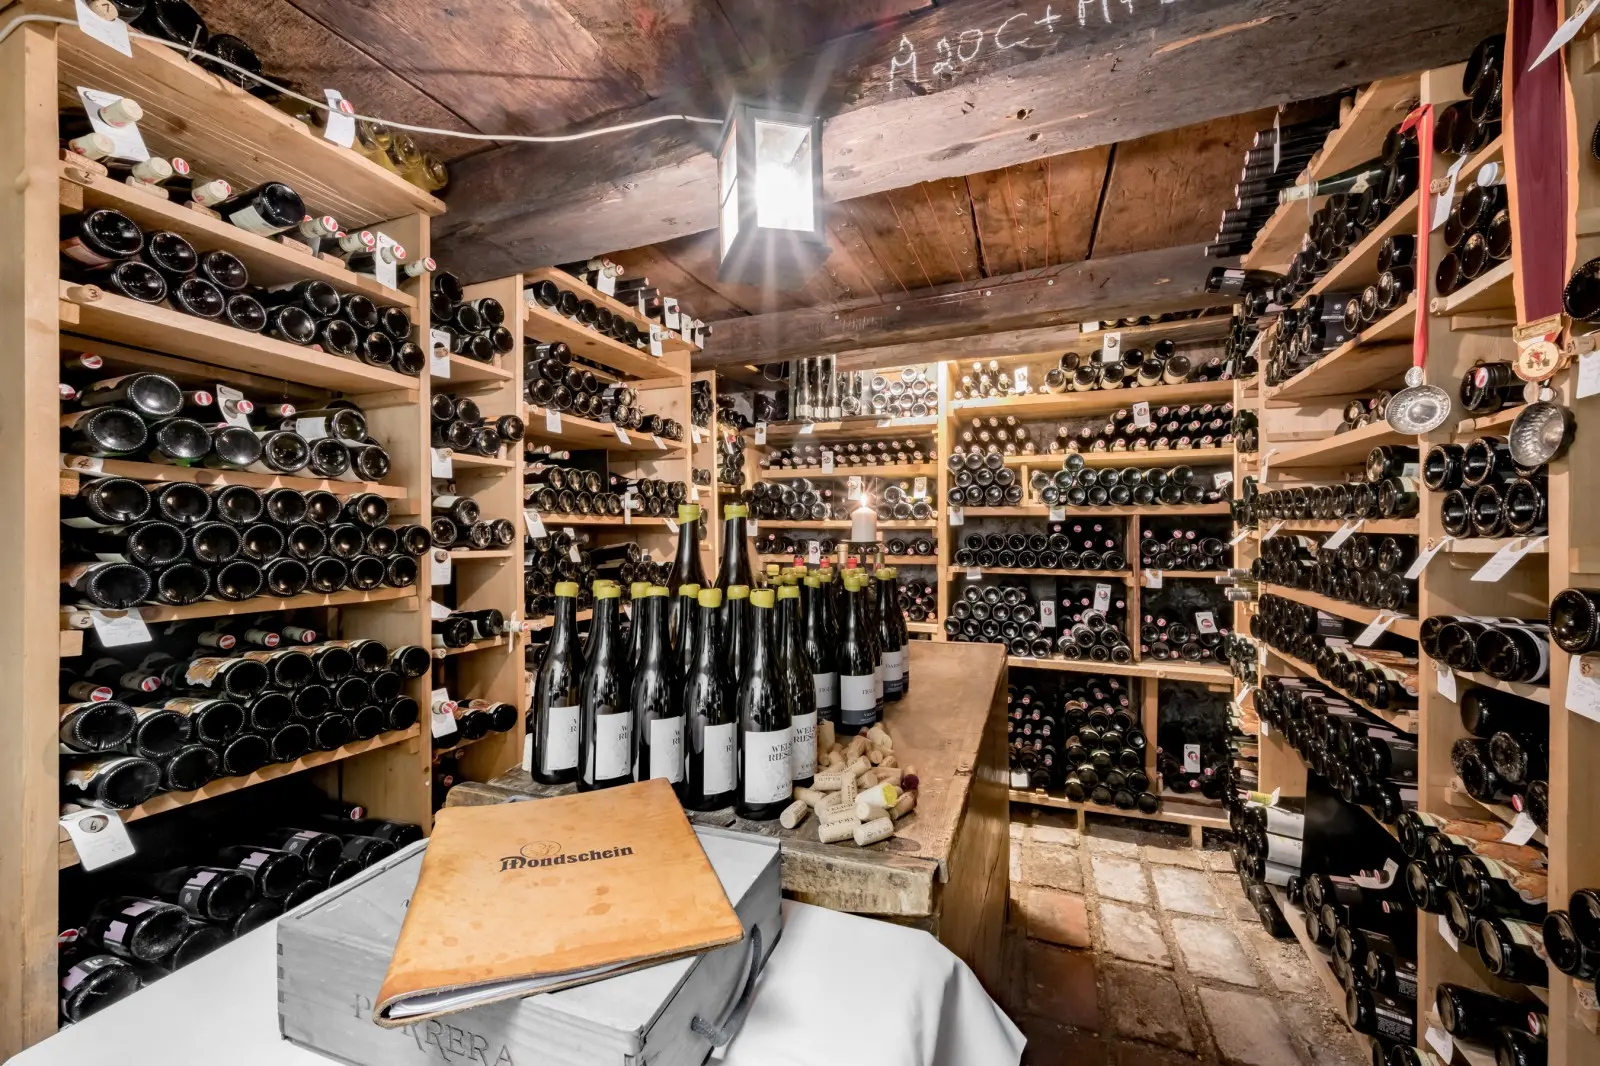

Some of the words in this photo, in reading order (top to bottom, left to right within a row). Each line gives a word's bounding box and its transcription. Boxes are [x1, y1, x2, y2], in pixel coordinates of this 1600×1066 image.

[89, 288, 98, 299] 3
[90, 821, 98, 831] 6
[499, 846, 634, 872] Mondschein
[350, 993, 515, 1066] PRRERA
